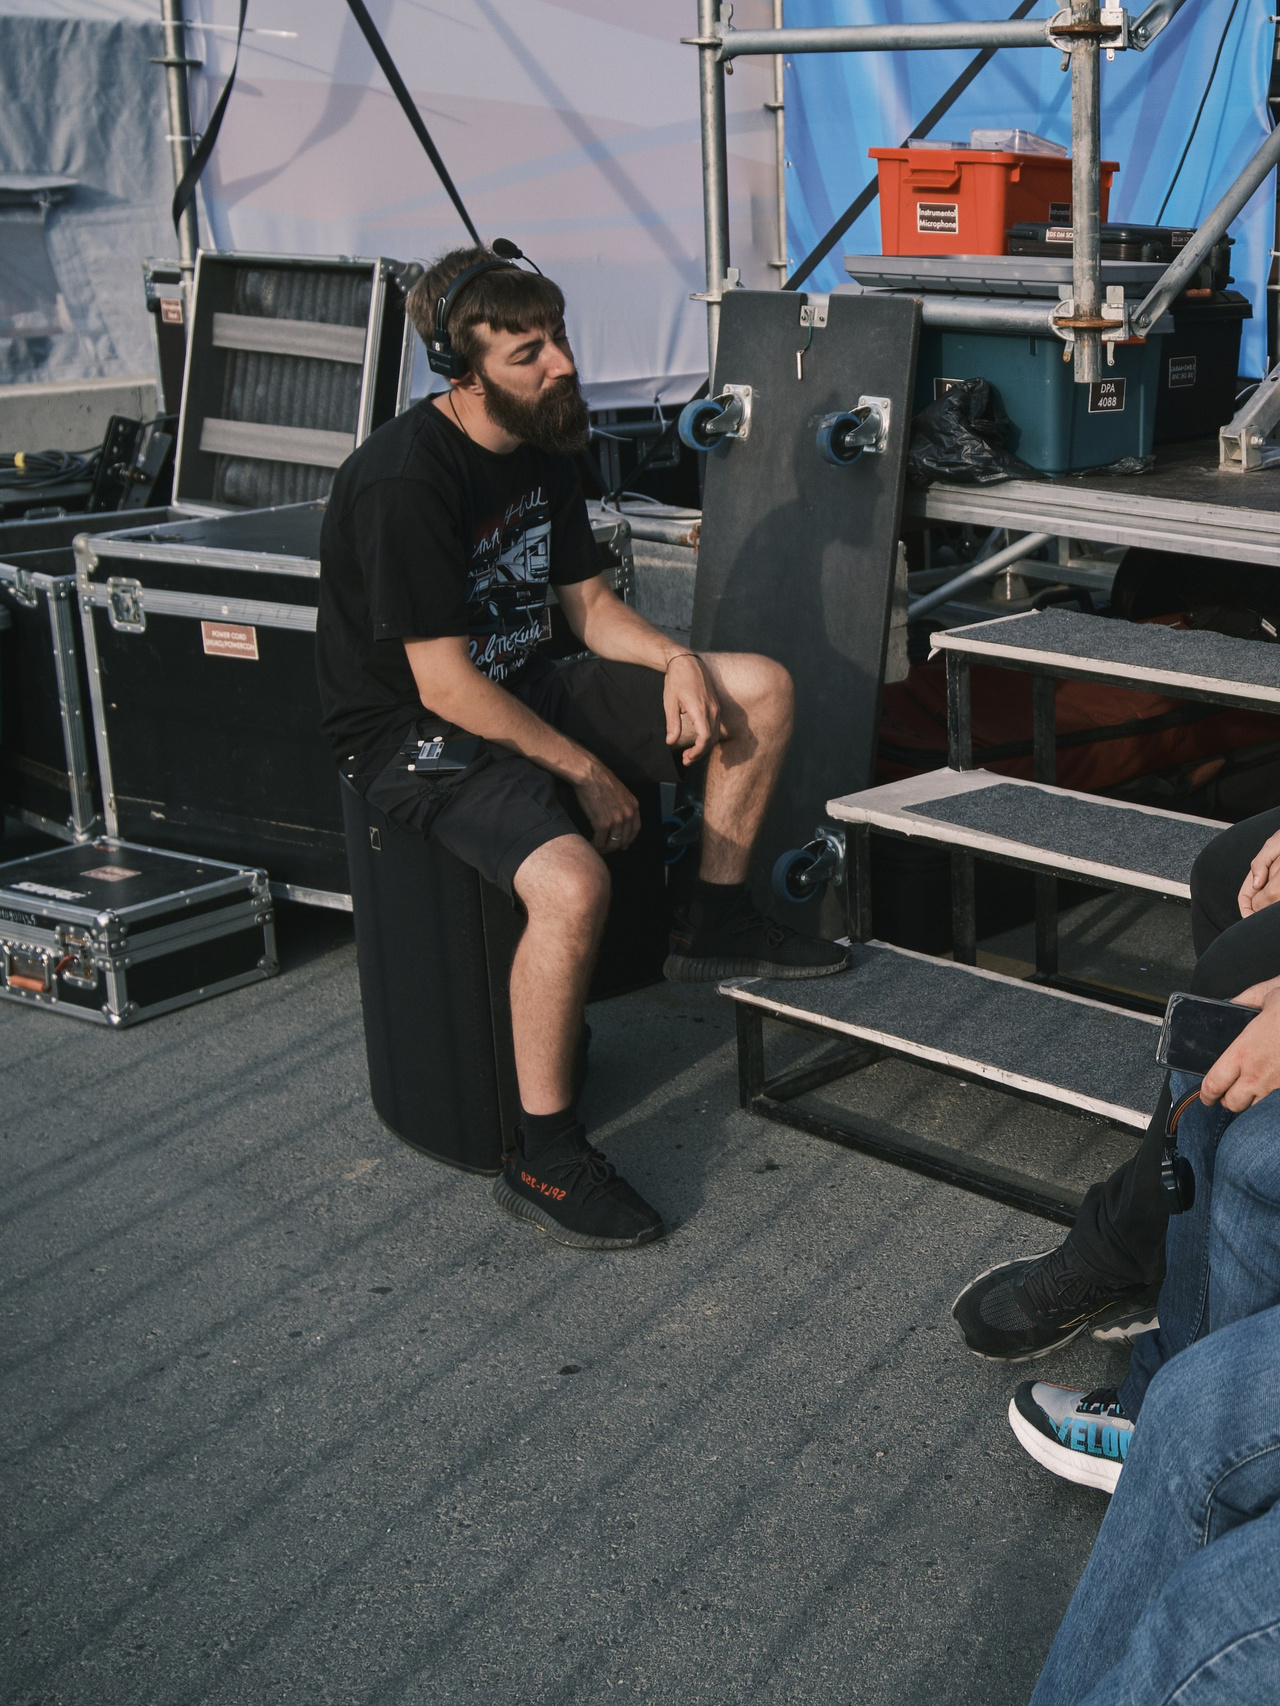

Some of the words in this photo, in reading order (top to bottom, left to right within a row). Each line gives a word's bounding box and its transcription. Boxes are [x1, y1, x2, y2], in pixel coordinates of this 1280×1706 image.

[919, 208, 956, 217] Instrumental
[919, 219, 956, 229] Microphone
[435, 342, 441, 352] 8
[1100, 383, 1116, 394] DPA
[1097, 397, 1117, 407] 4088
[212, 630, 230, 639] POWER
